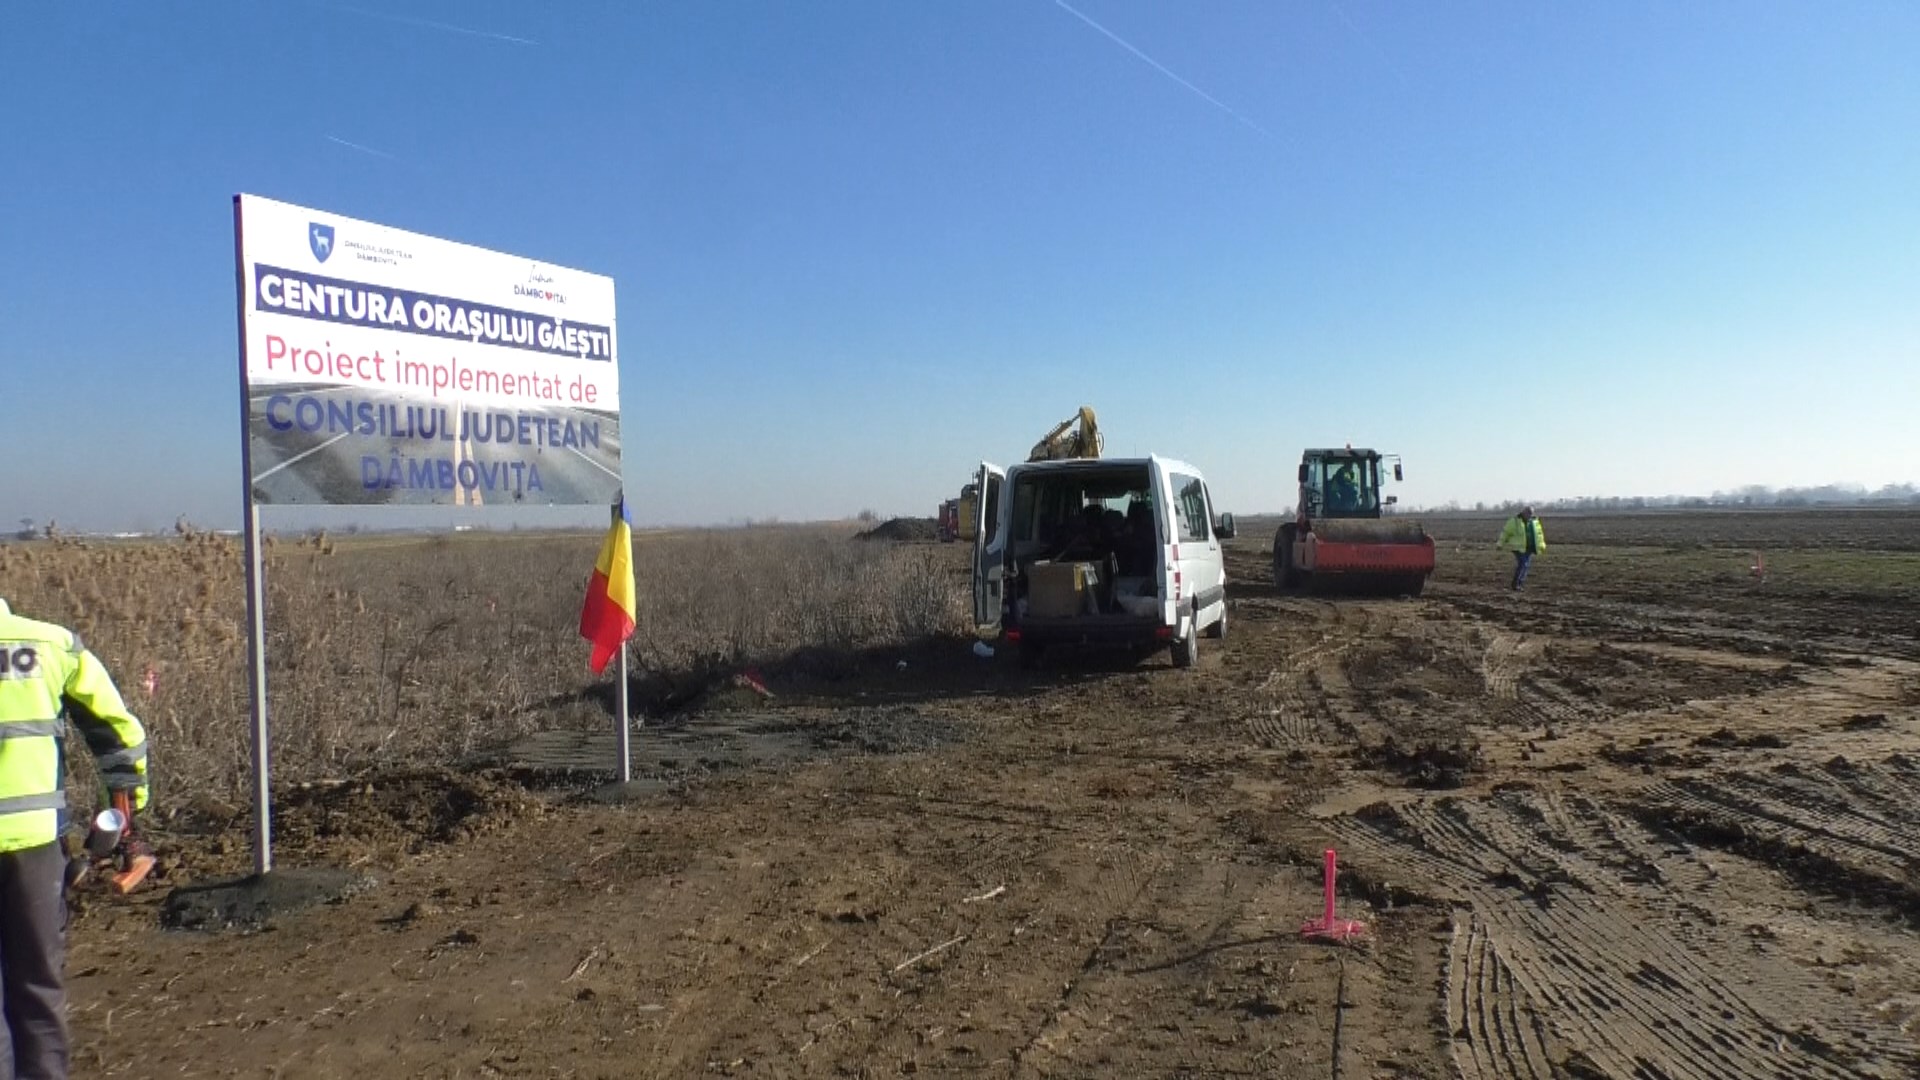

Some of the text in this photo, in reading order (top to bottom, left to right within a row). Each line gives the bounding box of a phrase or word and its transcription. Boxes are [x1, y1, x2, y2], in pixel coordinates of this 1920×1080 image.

[260, 274, 409, 325] CENTURA
[266, 334, 597, 403] Proiect implementat de
[265, 393, 455, 441] CONSILIUL
